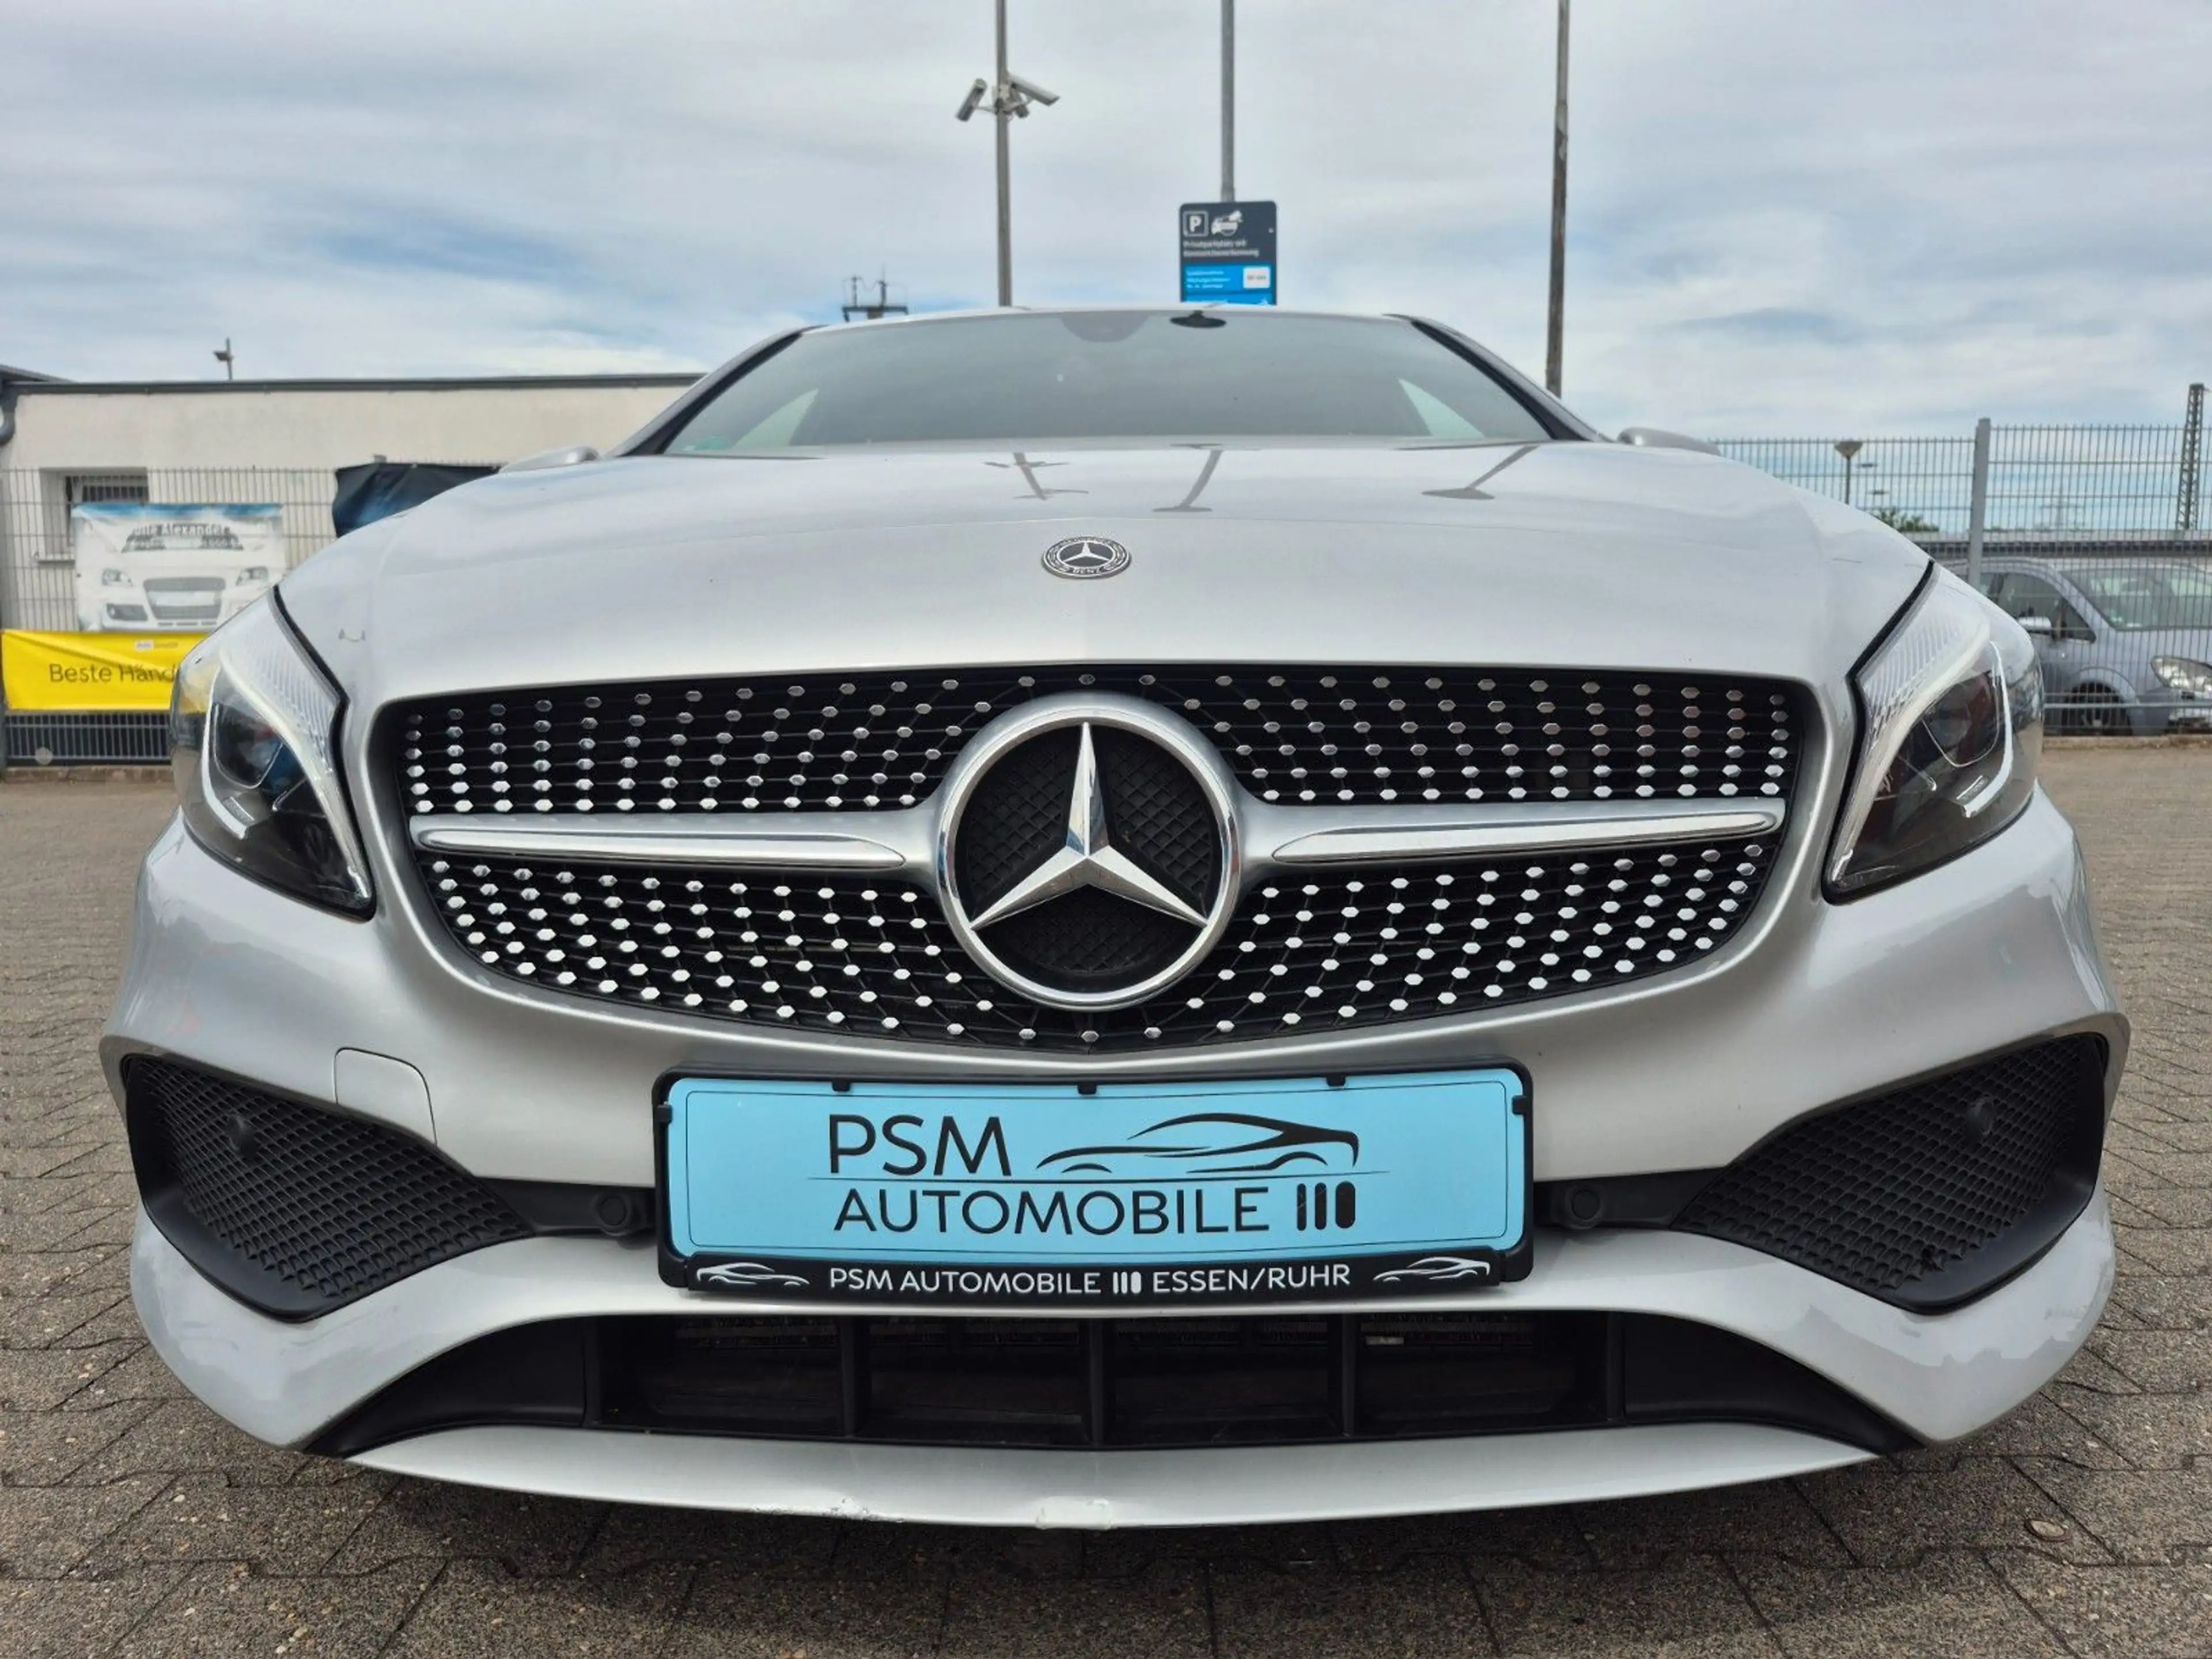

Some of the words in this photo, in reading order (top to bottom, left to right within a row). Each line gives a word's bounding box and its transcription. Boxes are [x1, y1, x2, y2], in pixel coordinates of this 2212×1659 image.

[1189, 215, 1202, 233] P
[49, 663, 112, 683] Beste
[829, 1114, 1012, 1176] PSM
[834, 1187, 1270, 1236] AUTOMOBILE
[830, 1267, 893, 1291] PSM
[899, 1270, 1101, 1294] AUTOMOBILE
[1153, 1264, 1350, 1293] ESSEN/RUHR
